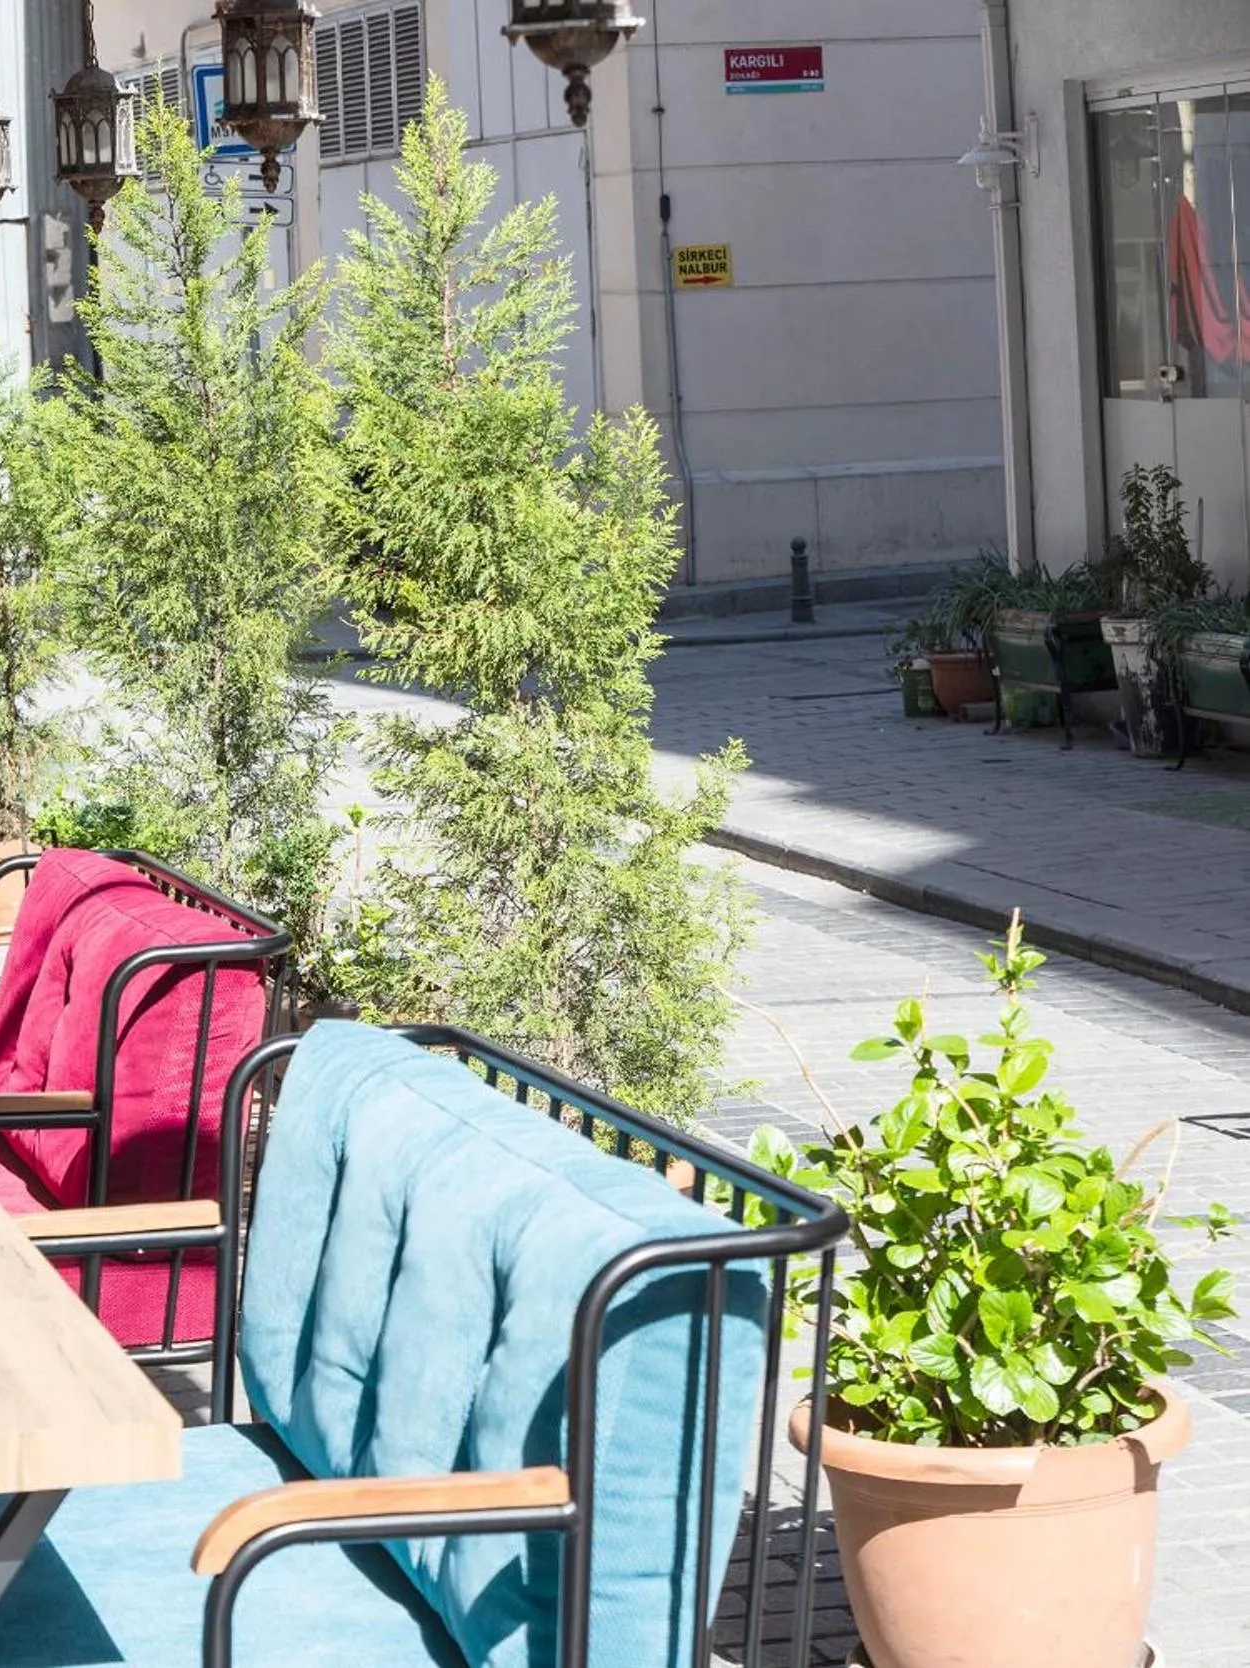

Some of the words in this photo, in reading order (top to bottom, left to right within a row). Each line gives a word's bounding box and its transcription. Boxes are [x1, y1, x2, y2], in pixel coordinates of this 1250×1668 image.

[730, 54, 784, 69] KARGILI
[678, 247, 727, 262] SİRKECİ
[678, 262, 728, 276] NALBUR
